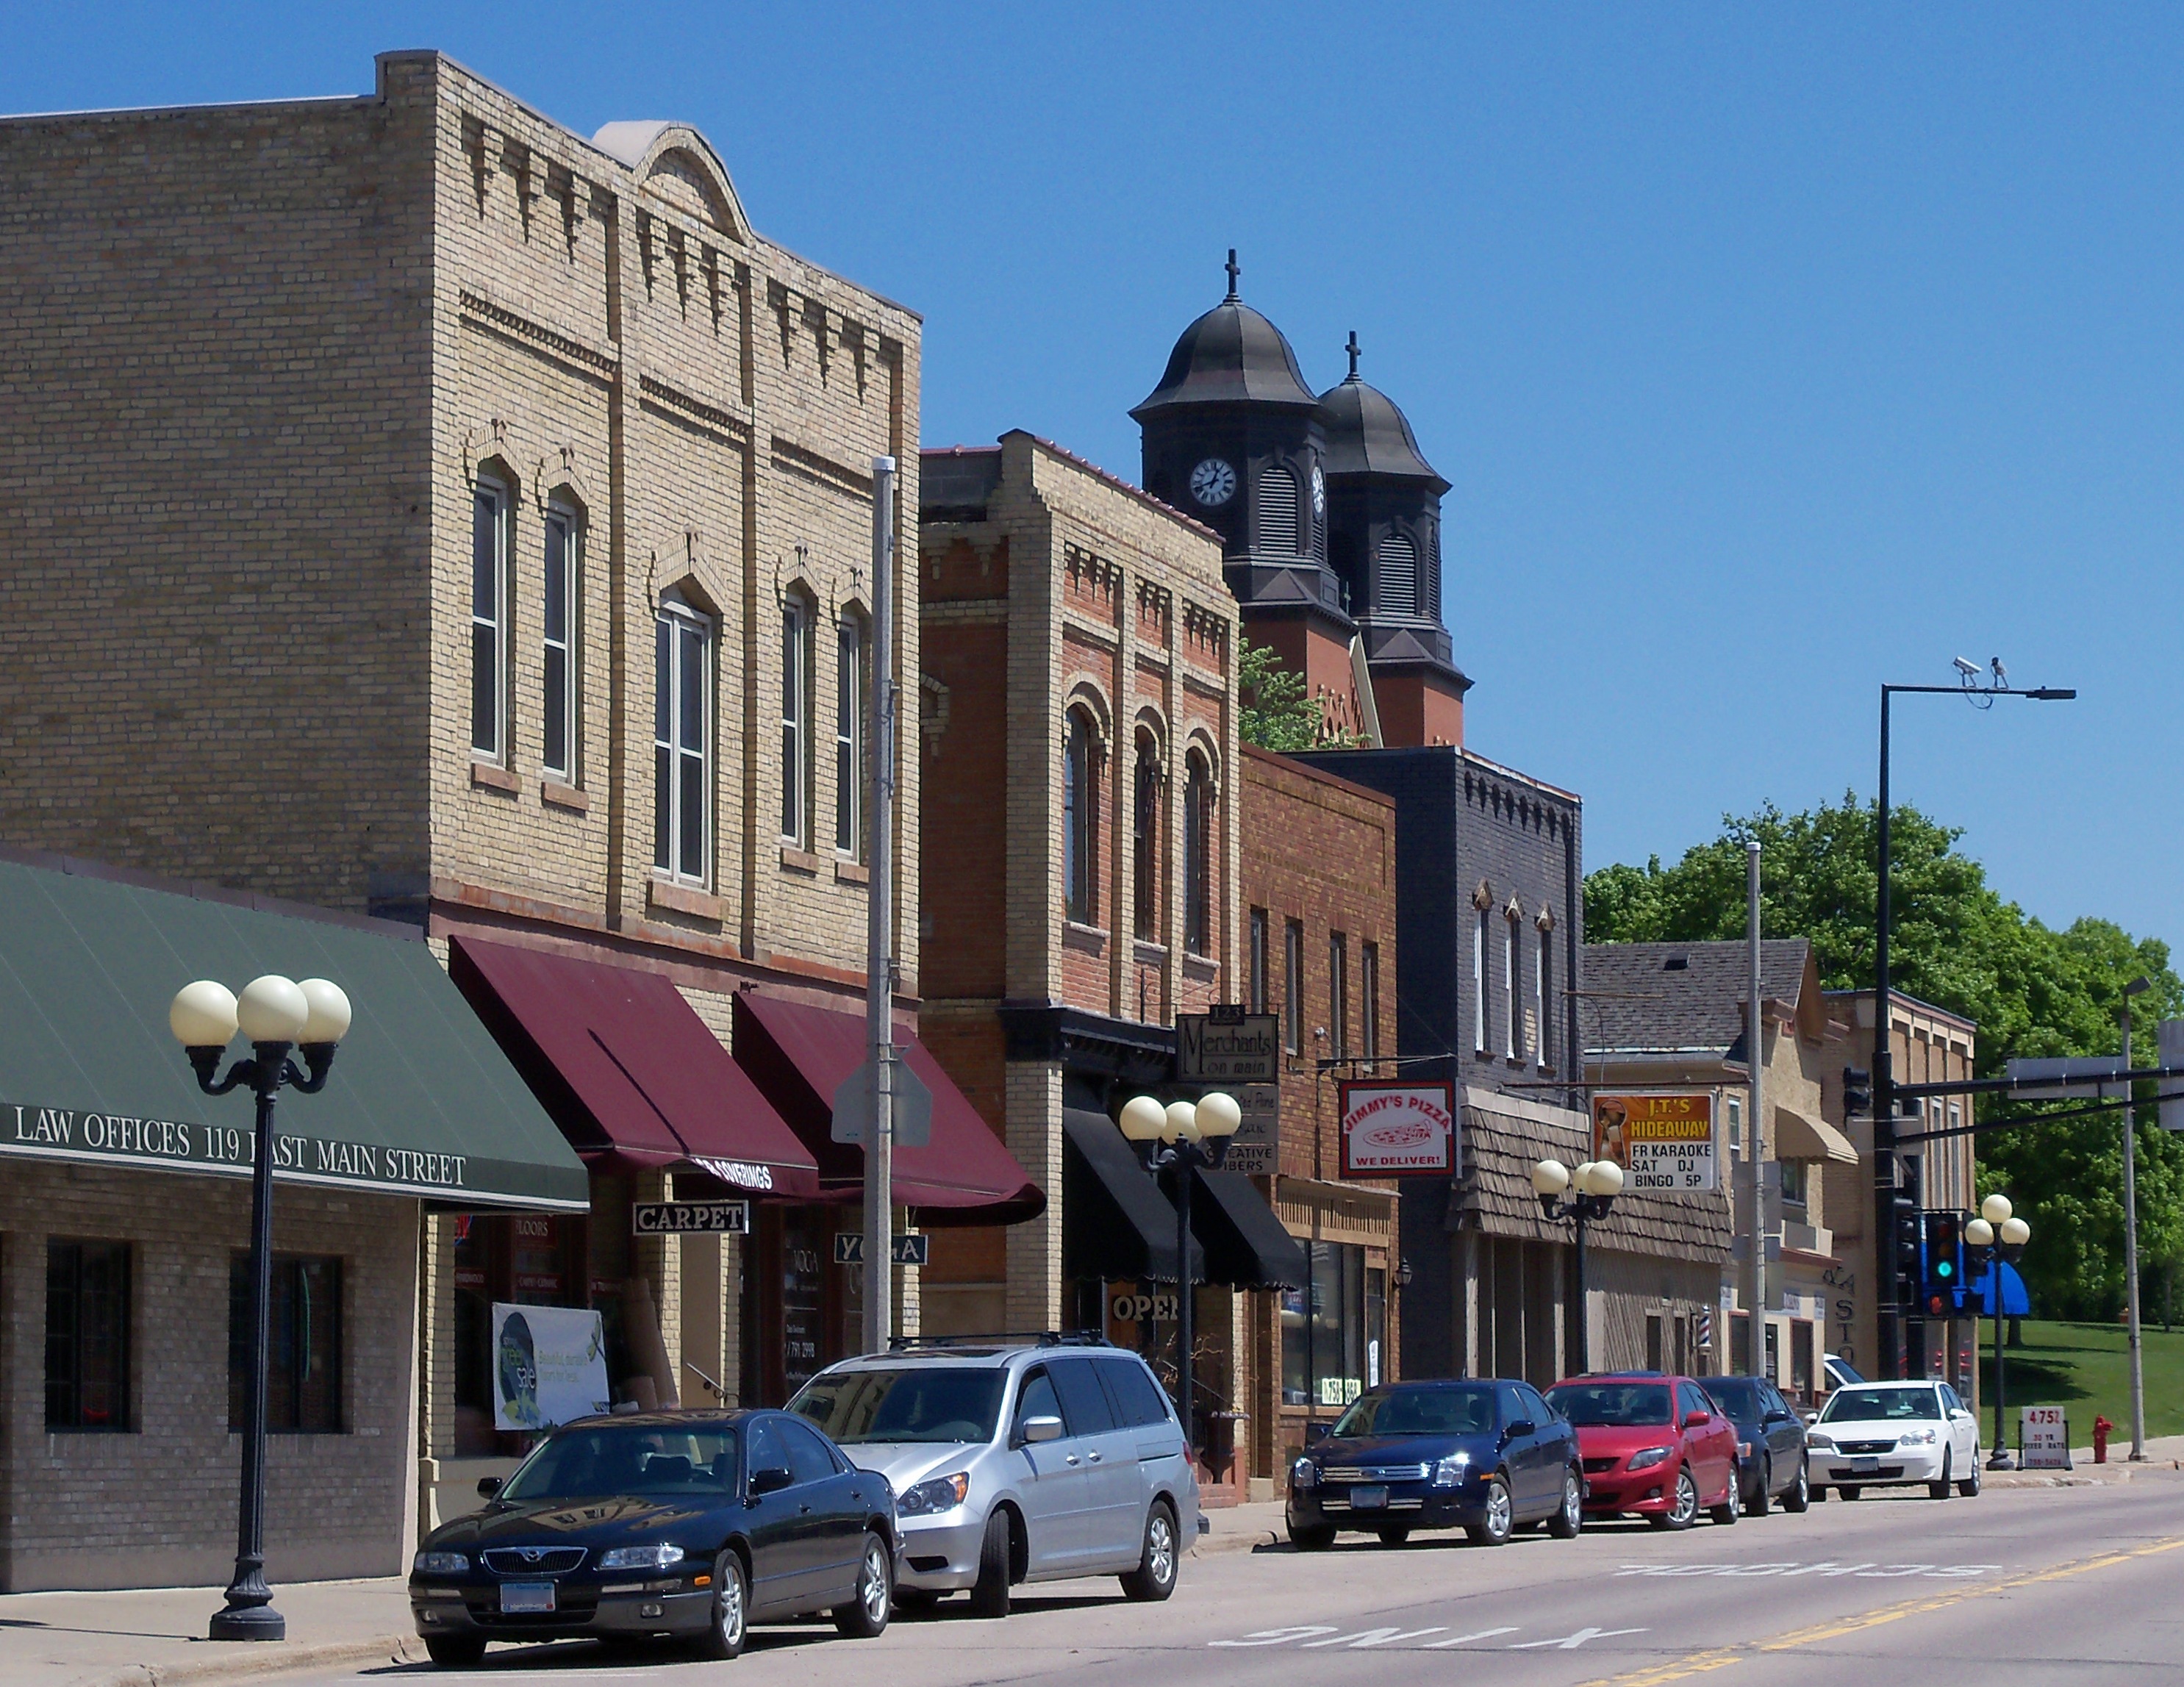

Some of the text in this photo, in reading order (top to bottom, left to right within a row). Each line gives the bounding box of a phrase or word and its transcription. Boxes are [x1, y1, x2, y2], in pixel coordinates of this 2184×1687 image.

[1180, 1019, 1271, 1074] Merchants
[1208, 1060, 1265, 1073] on main
[1345, 1096, 1450, 1132] JIMMY'S PIZZA
[1630, 1120, 1708, 1138] HIDEAWAY
[15, 1106, 74, 1144] LAW
[84, 1113, 190, 1157] OFFICES
[204, 1126, 240, 1161] 119
[317, 1140, 376, 1176] MAIN
[386, 1148, 466, 1186] STREET
[1206, 1148, 1272, 1158] CEATIVE
[1633, 1145, 1711, 1156] FR KARAOKE
[1224, 1161, 1263, 1171] IBERS
[1356, 1156, 1440, 1165] WE DELIVER!
[1632, 1160, 1694, 1172] SAT DJ
[1636, 1175, 1701, 1186] BINGO 5P
[638, 1206, 742, 1230] CARPET
[842, 1236, 920, 1260] YA
[1209, 1626, 1650, 1648] XING
